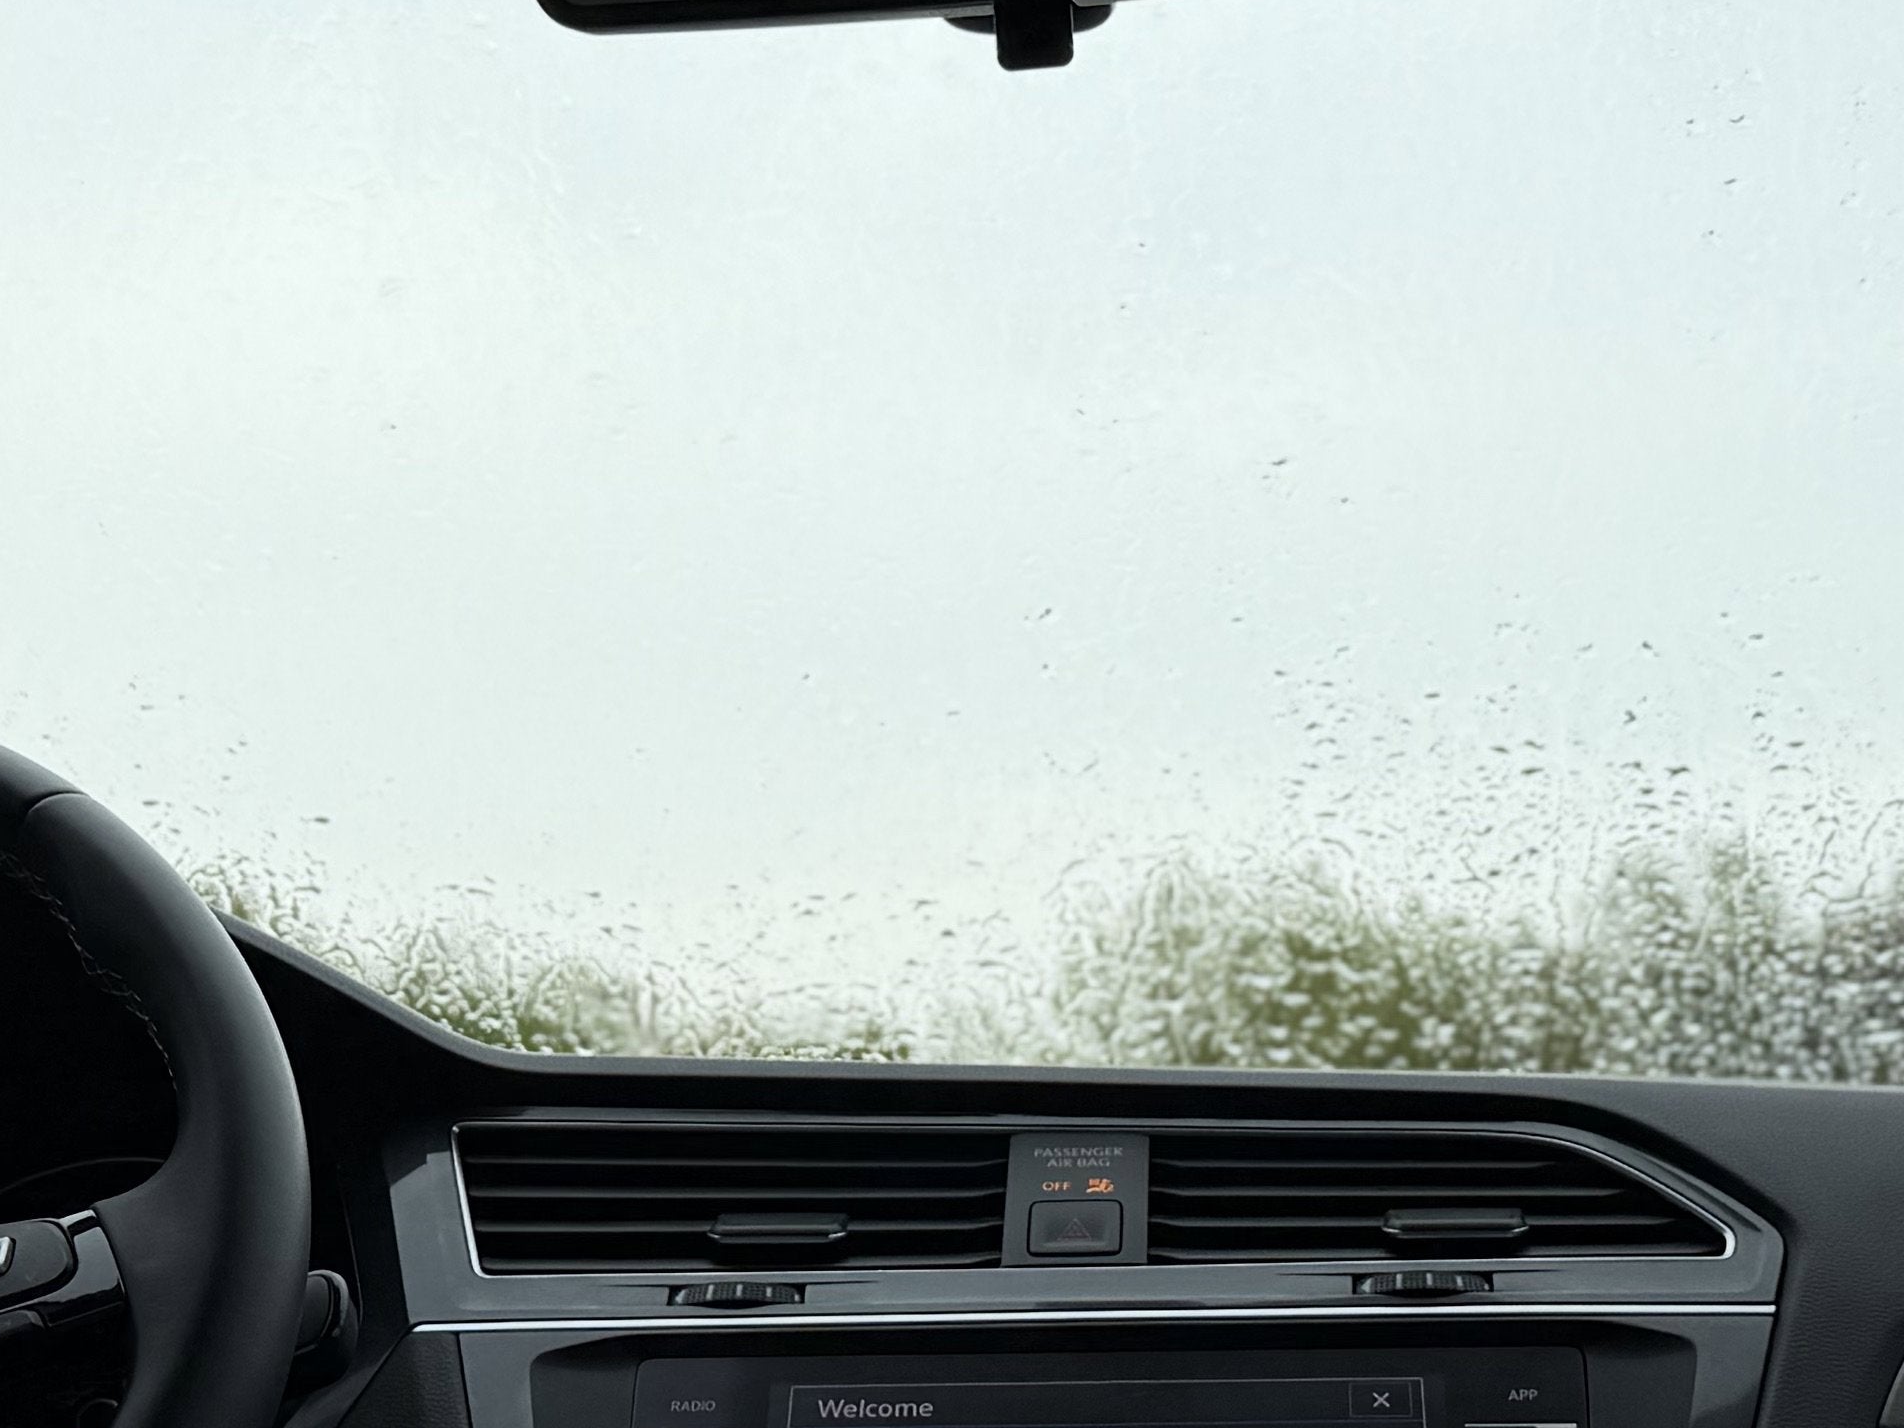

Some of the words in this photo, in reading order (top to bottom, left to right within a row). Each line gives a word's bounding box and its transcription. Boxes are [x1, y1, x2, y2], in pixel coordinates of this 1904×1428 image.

[1033, 1147, 1124, 1158] PASSENGER
[1046, 1158, 1075, 1168] AIR
[1076, 1158, 1111, 1168] BAG
[1041, 1180, 1073, 1192] OFF
[1507, 1388, 1539, 1402] APP
[670, 1399, 717, 1413] RADIO
[818, 1398, 935, 1419] Welcome
